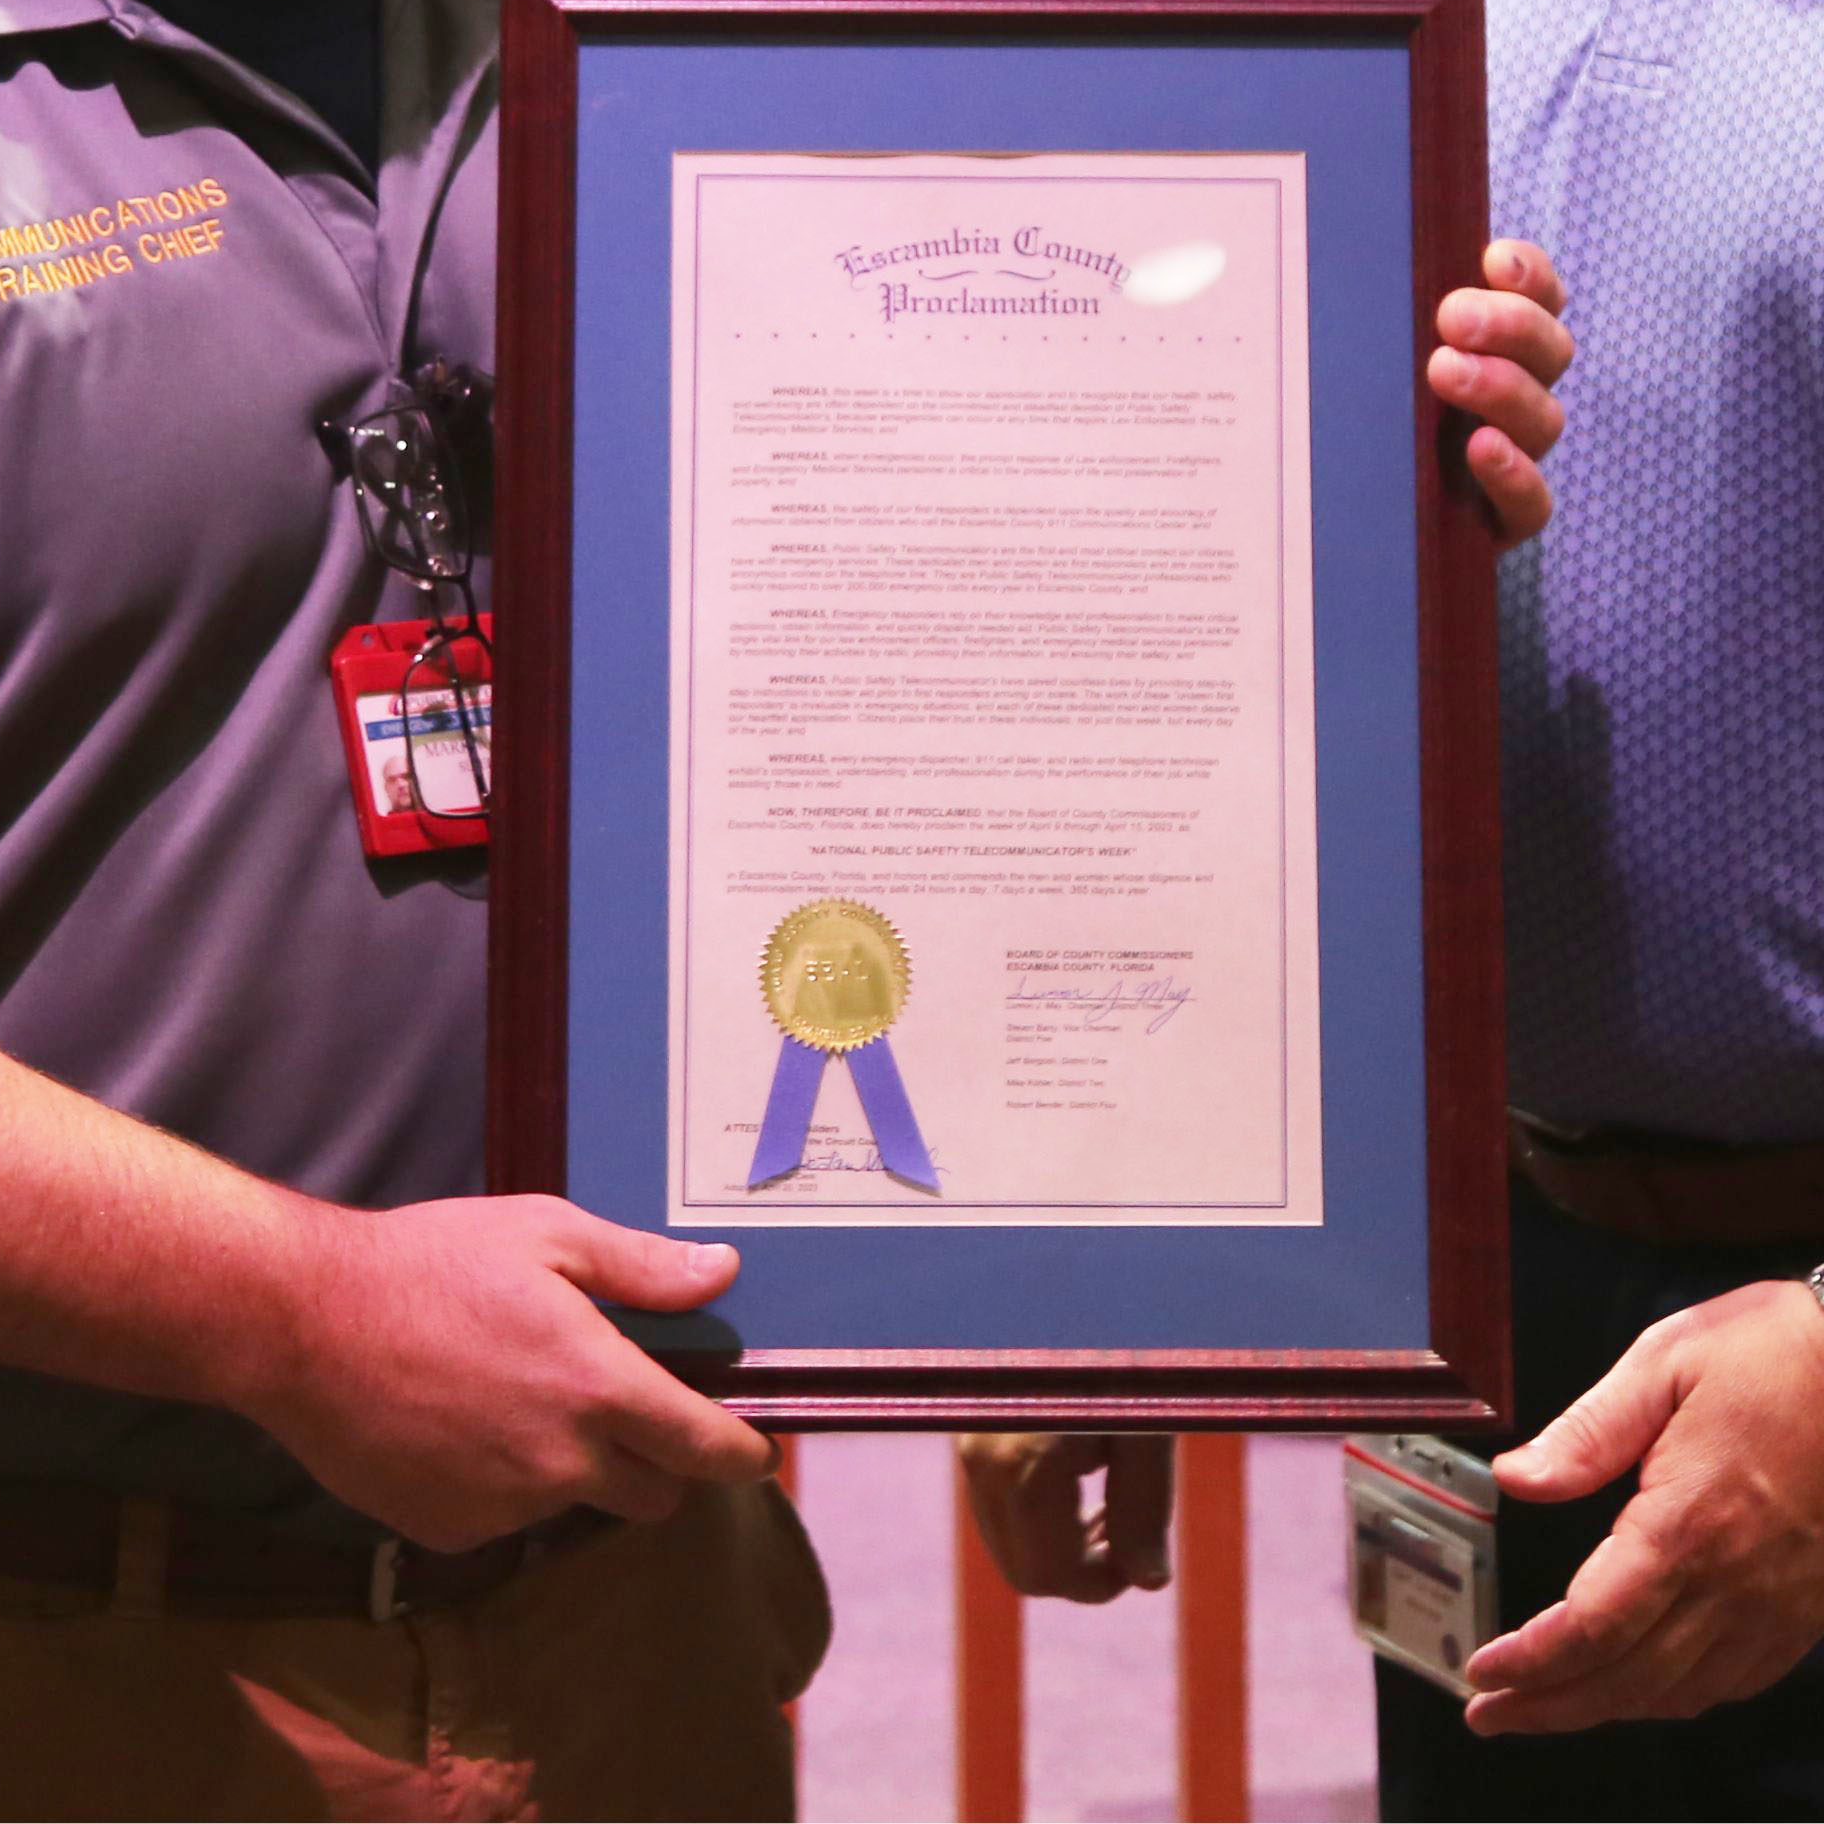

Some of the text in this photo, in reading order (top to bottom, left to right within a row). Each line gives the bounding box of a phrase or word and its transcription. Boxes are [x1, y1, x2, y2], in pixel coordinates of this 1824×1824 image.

[137, 219, 226, 264] CHIEF
[834, 226, 1132, 293] Escambia County
[879, 282, 1101, 324] Proclamation
[1006, 951, 1194, 960] BOARD OF COUNTY COMMISSIONERS
[1006, 963, 1060, 972] ESCAMBIA
[1110, 963, 1155, 972] FLORIDA
